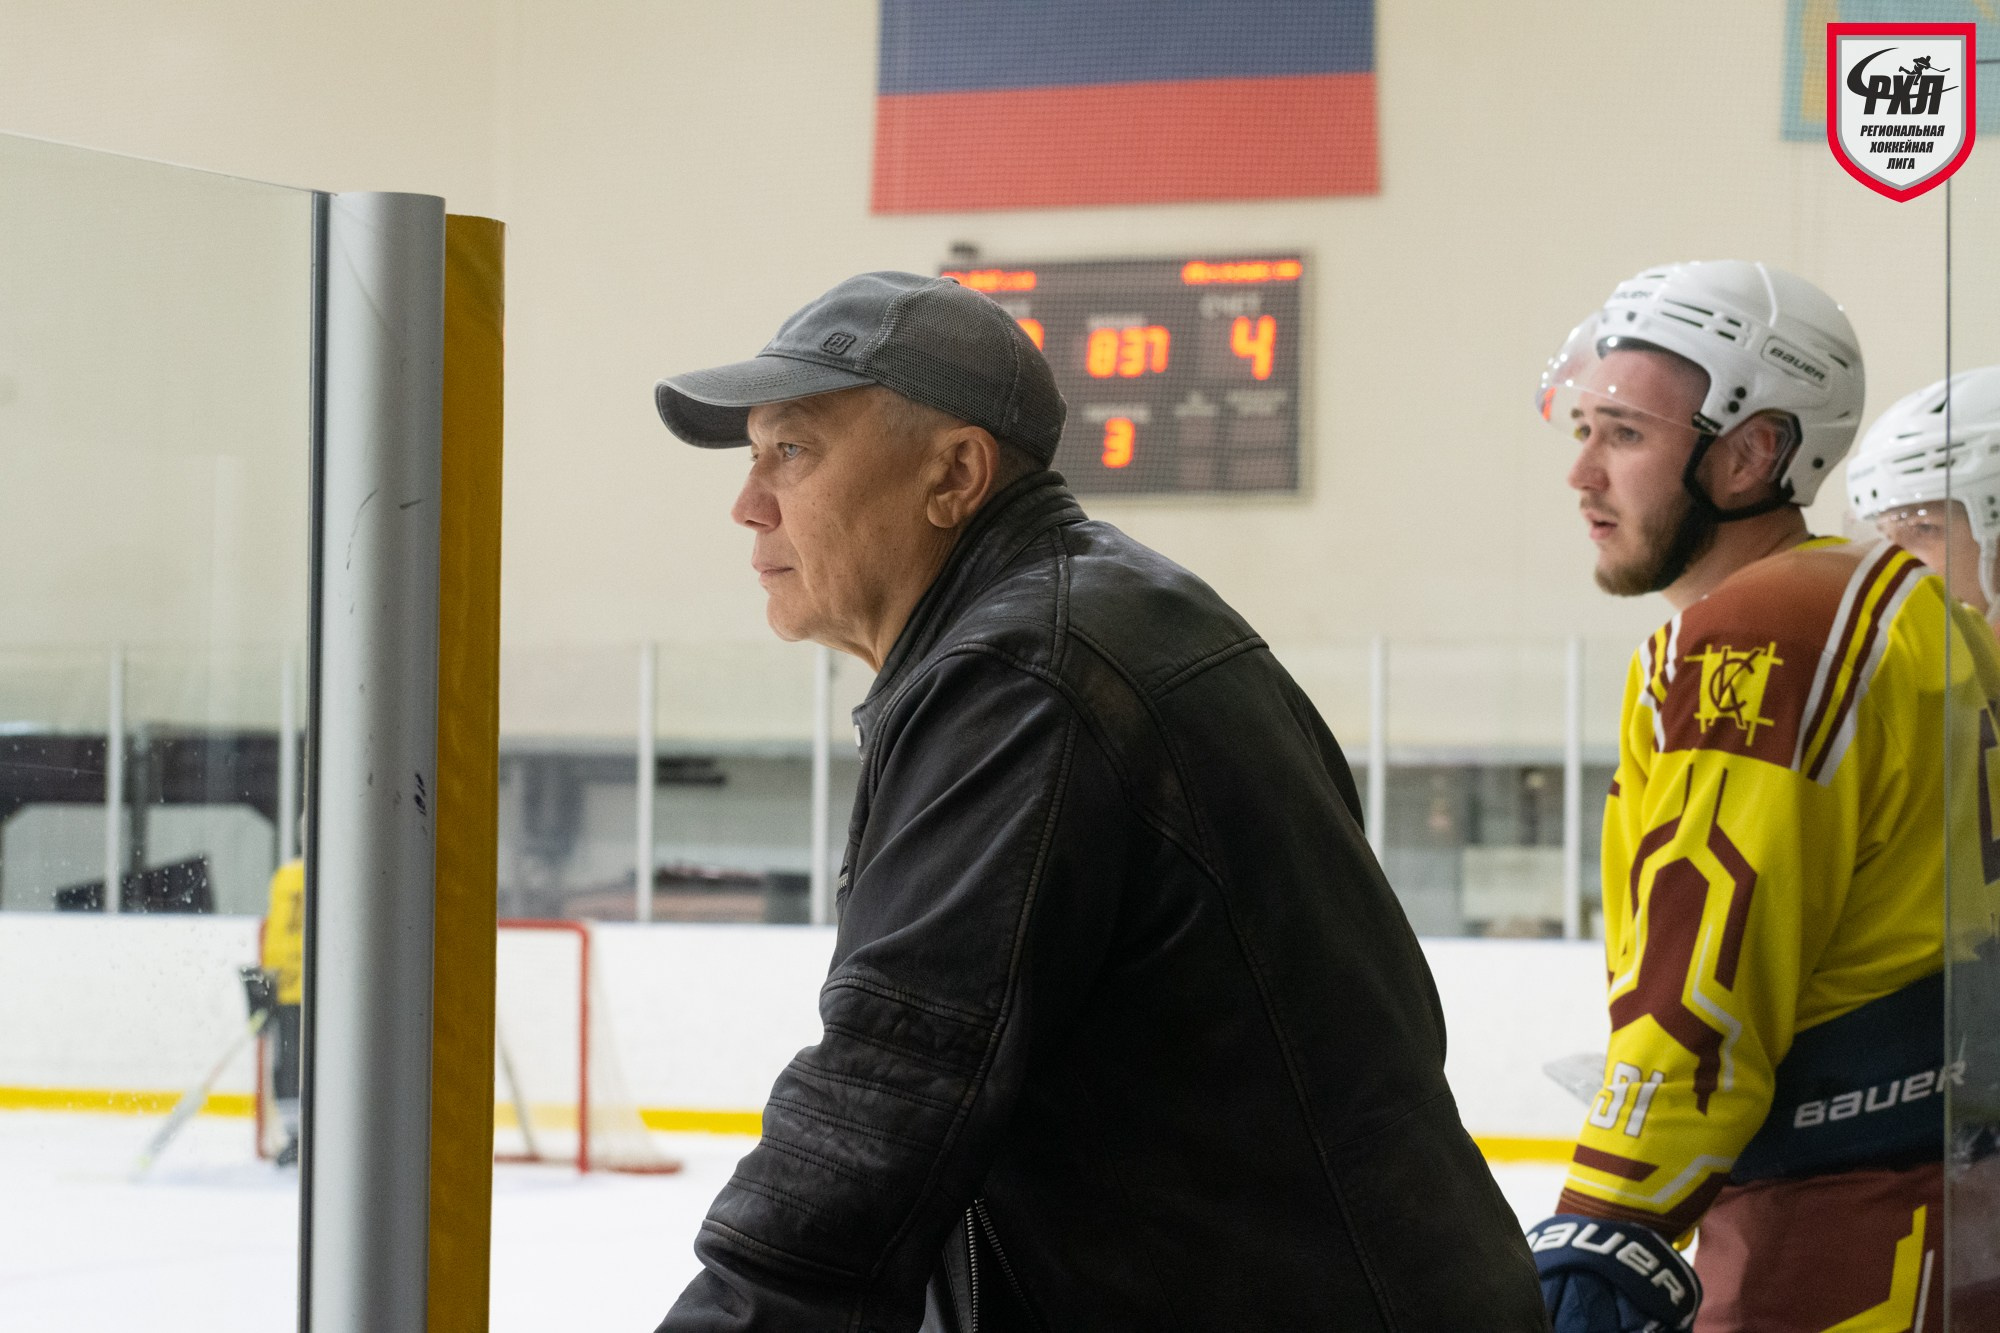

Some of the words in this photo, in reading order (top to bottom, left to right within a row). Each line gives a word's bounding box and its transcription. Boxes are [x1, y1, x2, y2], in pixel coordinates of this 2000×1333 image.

[1230, 315, 1277, 381] 4
[1770, 347, 1826, 381] BAUER
[1102, 417, 1136, 468] 3
[1793, 1060, 1967, 1129] BAUER
